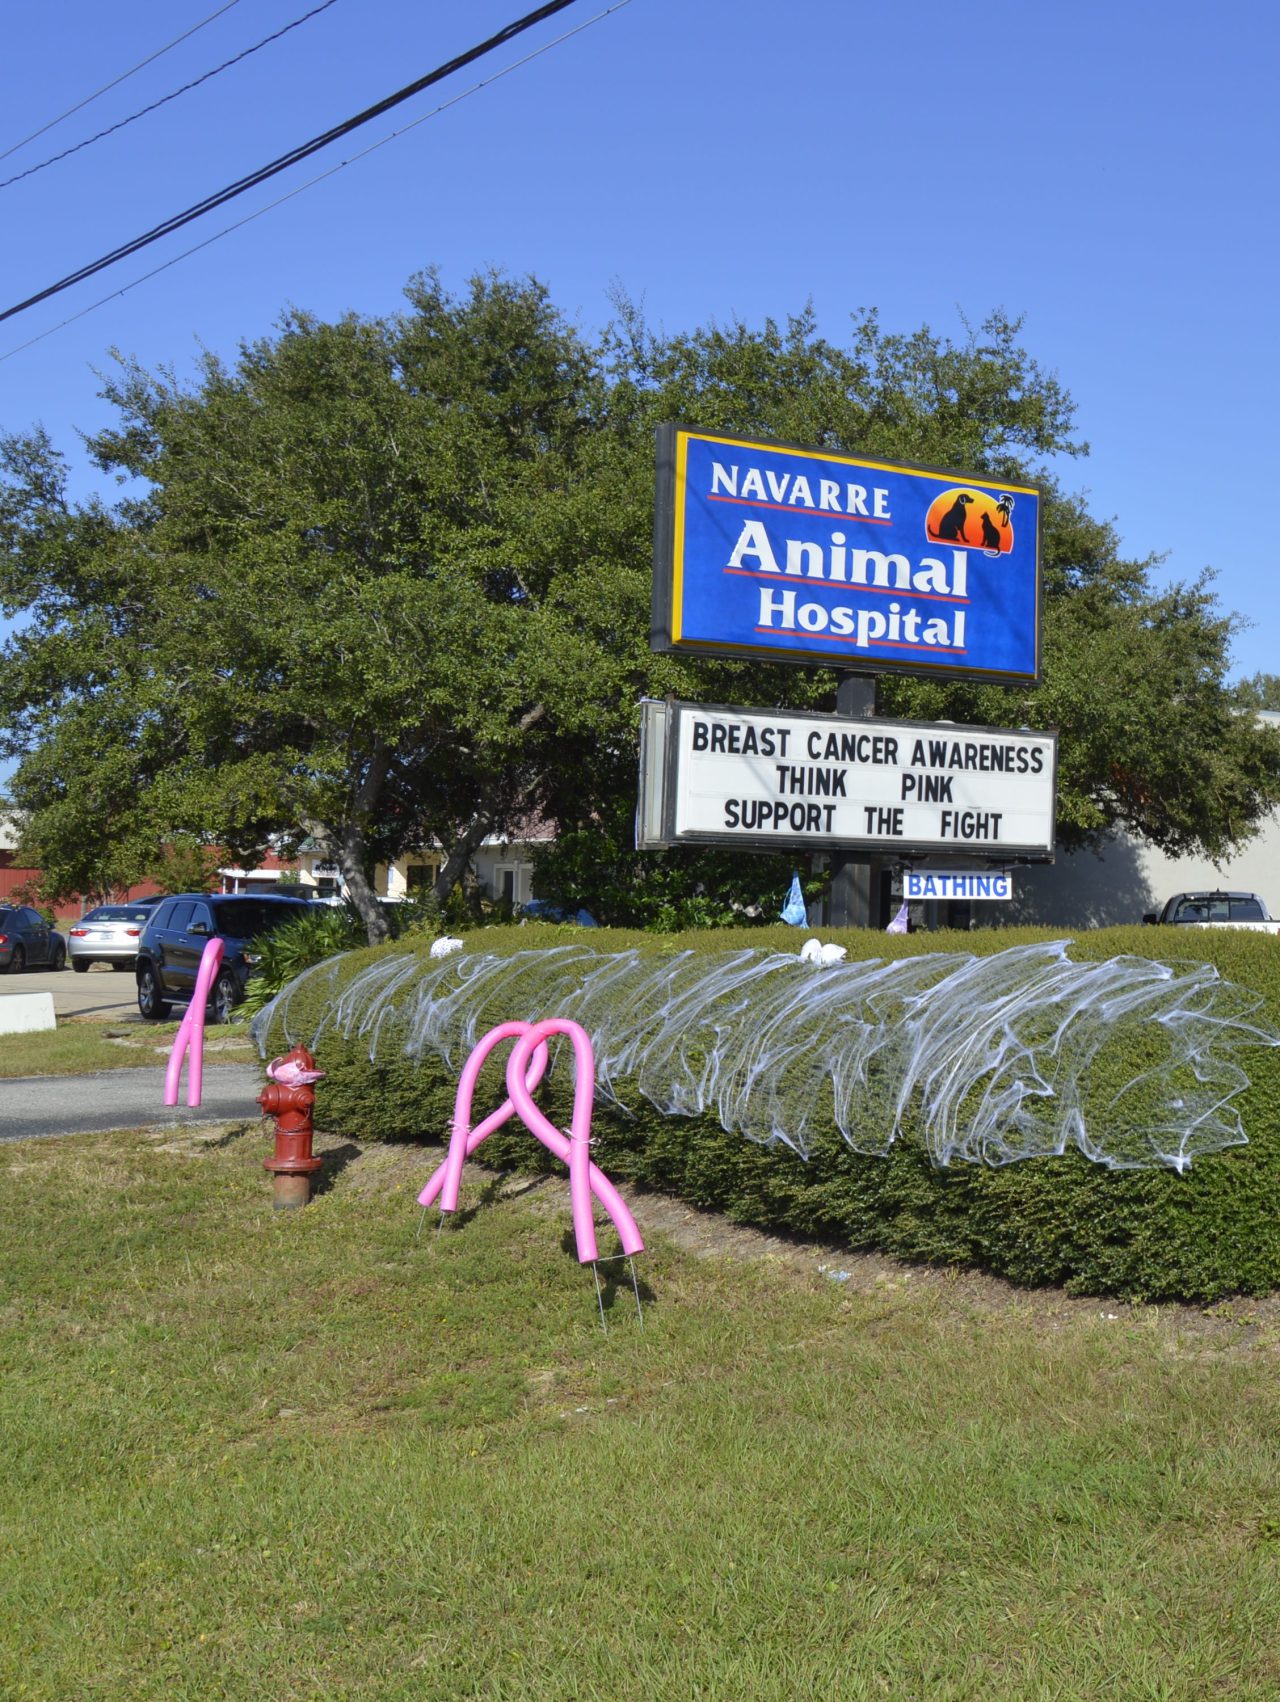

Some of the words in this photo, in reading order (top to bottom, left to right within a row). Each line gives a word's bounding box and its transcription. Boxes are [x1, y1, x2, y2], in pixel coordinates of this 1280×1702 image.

[711, 462, 891, 519] NAVARRE
[726, 519, 968, 597] Animal
[758, 587, 966, 648] Hospital
[693, 721, 790, 756] BREAST
[807, 731, 898, 765] CANCER
[911, 739, 1043, 774] AWARENESS
[776, 765, 847, 797] THINK
[901, 773, 953, 803] PINK
[725, 799, 836, 832] SUPPORT
[864, 806, 904, 836] THE
[940, 811, 1002, 840] FIGHT
[908, 874, 1007, 898] BATHING
